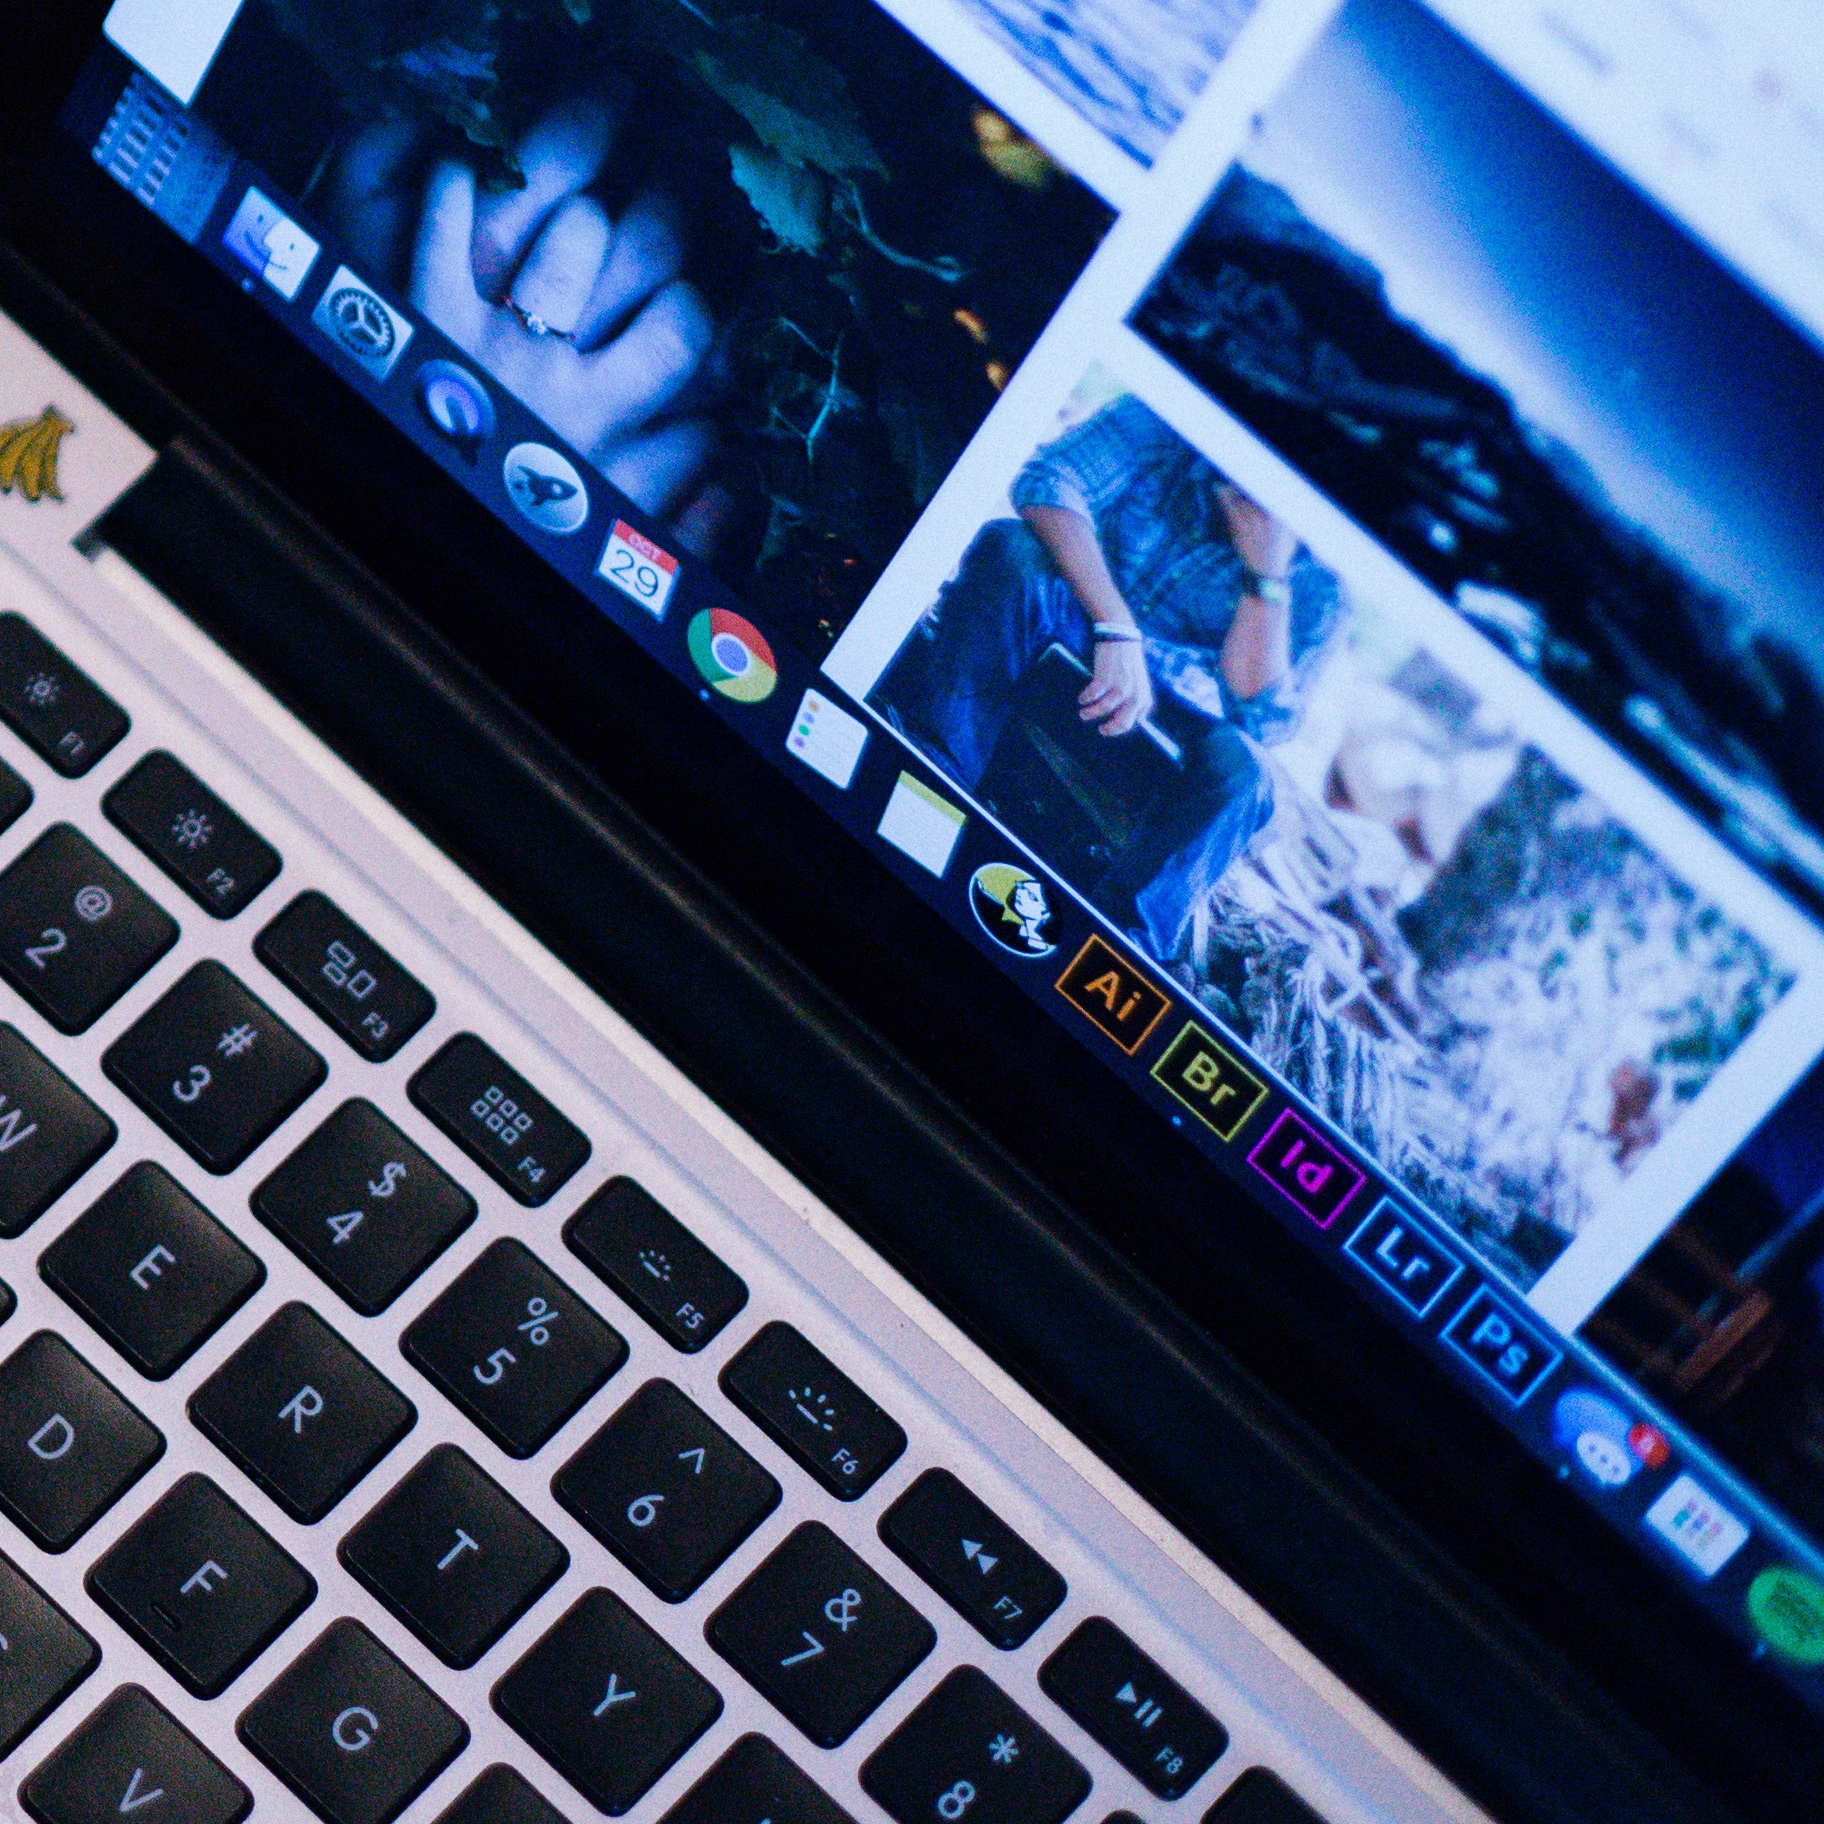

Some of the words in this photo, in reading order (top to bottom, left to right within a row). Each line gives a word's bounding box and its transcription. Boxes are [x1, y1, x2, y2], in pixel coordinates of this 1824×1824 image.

[609, 549, 659, 598] 29
[59, 730, 85, 755] F1
[206, 868, 235, 896] F2
[75, 886, 112, 921] @
[24, 927, 67, 968] 2
[1083, 969, 1144, 1024] Ai
[217, 1024, 257, 1057] #
[361, 1011, 388, 1040] F3
[172, 1064, 212, 1102] 3
[1181, 1050, 1236, 1108] Br
[368, 1161, 407, 1198] $
[517, 1156, 546, 1183] F4
[1279, 1139, 1334, 1196] Id
[326, 1210, 364, 1244] 4
[129, 1244, 176, 1289] E
[1374, 1227, 1429, 1280] Lr
[517, 1296, 559, 1346] %
[675, 1302, 704, 1329] F5
[1468, 1314, 1529, 1375] Ps
[473, 1347, 516, 1385] 5
[278, 1385, 324, 1434] R
[27, 1413, 75, 1460] D
[831, 1447, 858, 1475] F6
[626, 1494, 664, 1527] 6
[437, 1528, 479, 1570] T
[180, 1559, 228, 1594] F
[824, 1587, 862, 1632] &
[993, 1595, 1023, 1620] F7
[780, 1630, 825, 1667] 7
[592, 1673, 636, 1717] Y
[331, 1705, 379, 1751] G
[1155, 1746, 1183, 1775] F8
[119, 1767, 164, 1813] V
[936, 1780, 976, 1820] 8
